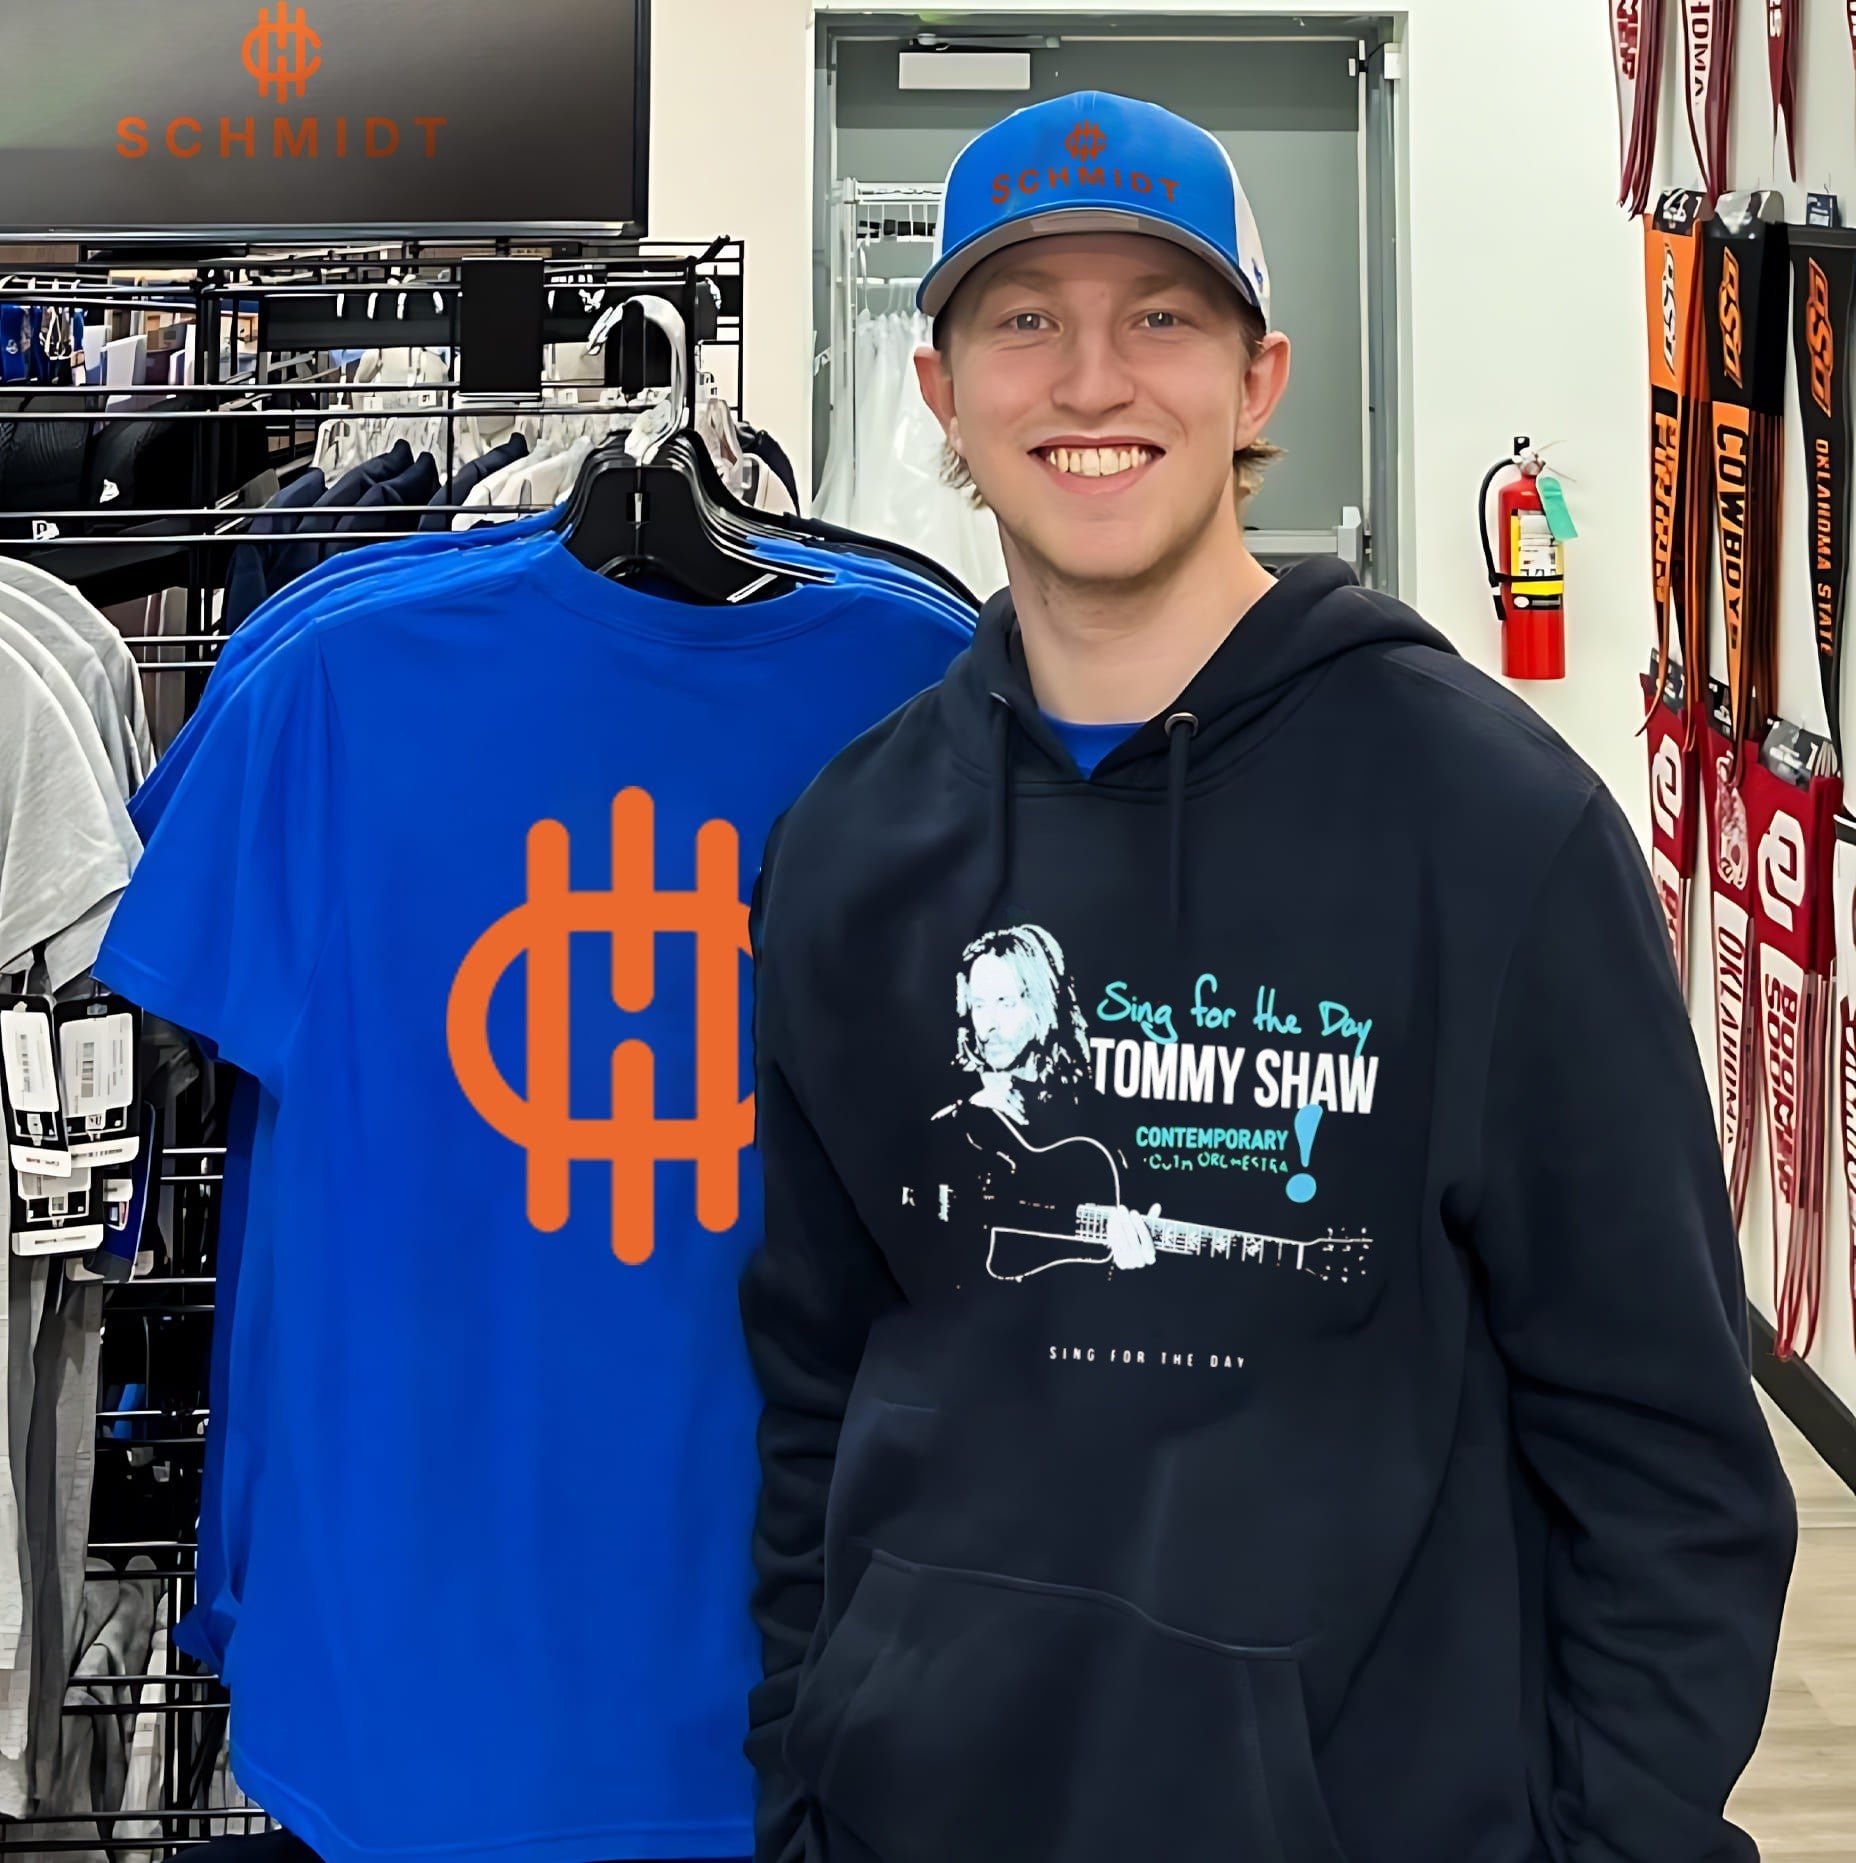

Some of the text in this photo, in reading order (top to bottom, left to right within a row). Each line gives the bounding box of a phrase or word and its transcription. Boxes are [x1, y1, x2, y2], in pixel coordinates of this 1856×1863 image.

[116, 117, 447, 158] SCHMIDT
[991, 167, 1179, 205] SCHMIDT
[1816, 438, 1832, 570] OKLAHOMA
[1096, 973, 1373, 1059] Sing for the Day
[1718, 926, 1745, 1143] OKLAHOMA
[1089, 1037, 1379, 1114] TOMMY SHAW
[1135, 1126, 1289, 1151] CONTEMPORARY
[1049, 1346, 1244, 1368] SING FOR THE DAY
